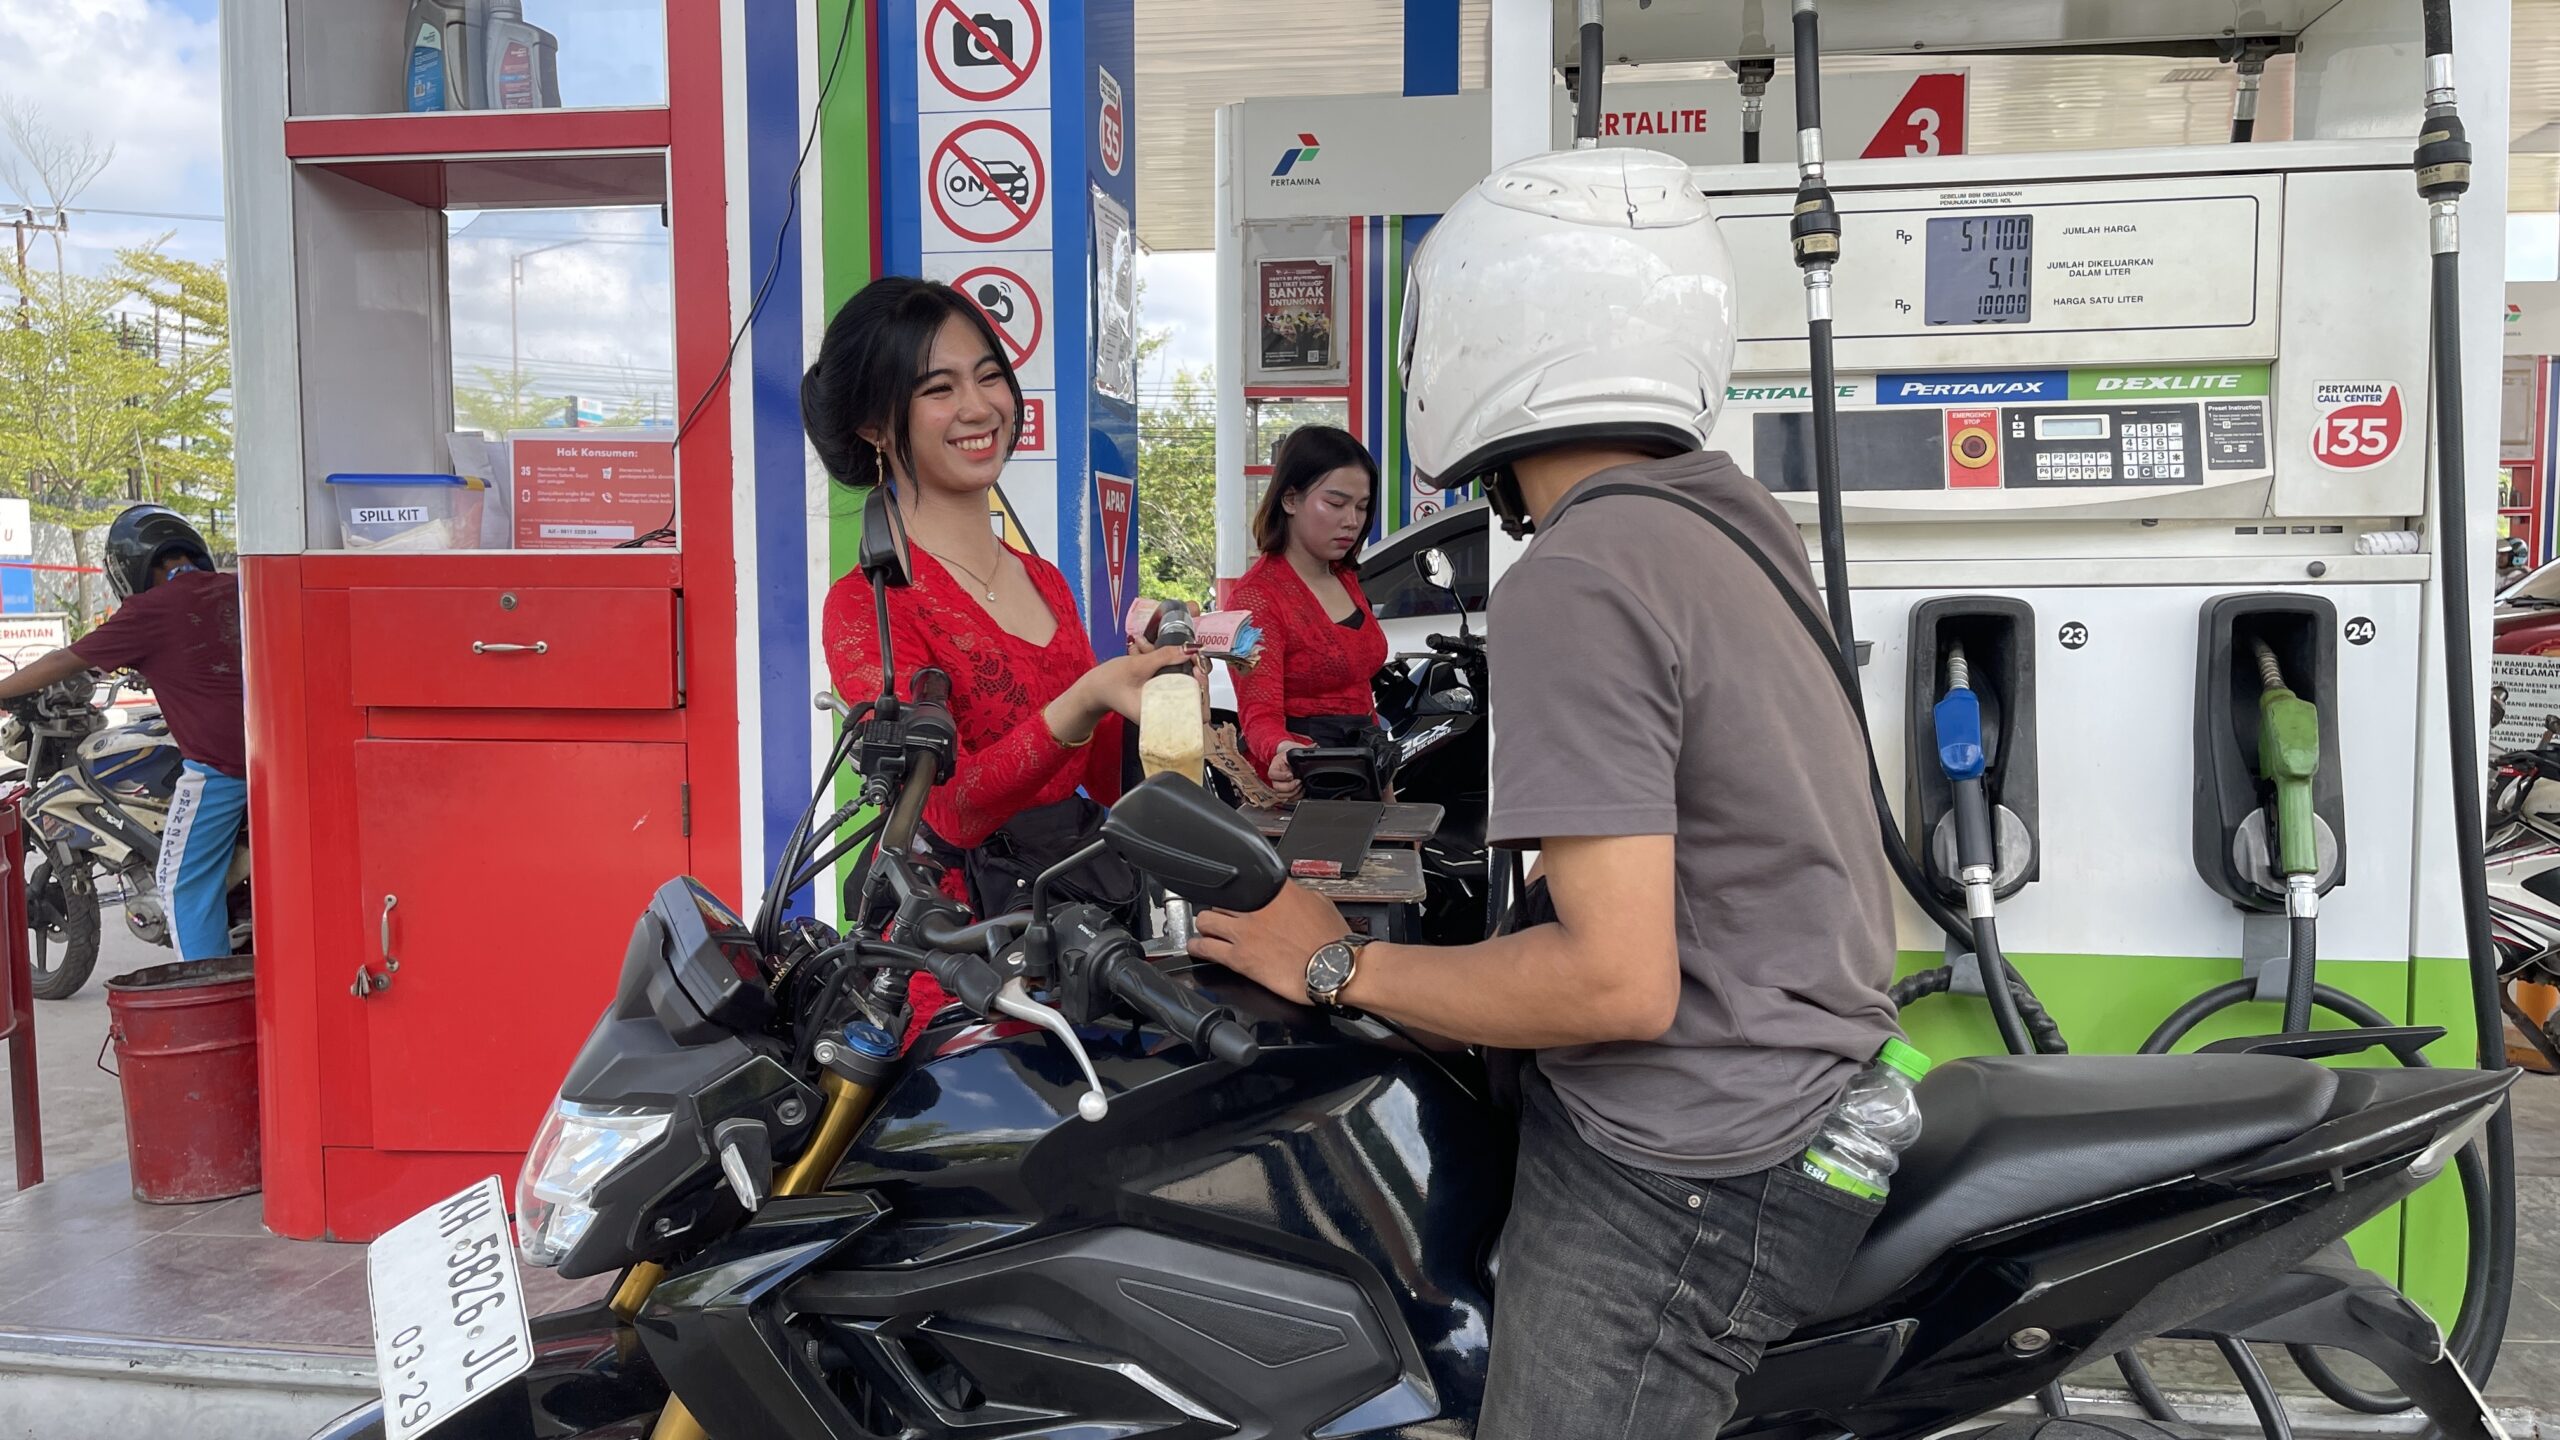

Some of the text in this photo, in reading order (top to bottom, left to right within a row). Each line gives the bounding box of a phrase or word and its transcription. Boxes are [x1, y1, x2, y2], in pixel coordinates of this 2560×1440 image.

[1598, 109, 1707, 136] RTALITE
[1904, 107, 1941, 157] 3
[1101, 114, 1120, 162] 135
[949, 175, 985, 193] ON
[1270, 177, 1321, 187] PERTAMINA
[1940, 192, 1967, 200] SEBELUM
[1982, 190, 2023, 198] DIKELUARKAN
[1960, 217, 2029, 252] 51100
[2062, 224, 2137, 235] JUMLAH HARGA
[2047, 258, 2154, 269] JUMLAH DIKELUARKAN
[2069, 268, 2131, 277] DALAM LITER
[1269, 286, 1324, 298] BANYAK
[1269, 298, 1325, 307] UNTUNGNYA
[1977, 294, 2027, 315] 10000
[2053, 295, 2144, 306] HARGA SATU LITER
[2096, 374, 2242, 392] DEXLITE
[1900, 381, 2044, 397] PERTAMAX
[2318, 384, 2383, 394] PERTAMINA
[2317, 394, 2382, 403] CALL CENTER
[1952, 411, 1992, 419] EMERGENCY
[2124, 425, 2132, 433] 7
[2140, 425, 2148, 433] 8
[2156, 424, 2163, 432] 9
[2126, 438, 2133, 446] 4
[2141, 438, 2149, 446] 5
[2156, 438, 2164, 446] 6
[2318, 418, 2388, 456] 135
[556, 447, 639, 458] Hak Konsumen:
[2127, 452, 2165, 460] 1 2 3
[520, 466, 532, 477] 3S
[2142, 467, 2150, 476] C
[1105, 488, 1126, 513] APAR
[360, 509, 420, 522] SPILL KIT
[2060, 626, 2087, 645] 23
[2346, 622, 2374, 640] 24
[2504, 661, 2560, 669] RAMBU-RAMB
[2501, 667, 2560, 677] KESELAMAT
[173, 789, 191, 824] SMPN
[166, 827, 181, 837] 12
[438, 1184, 518, 1392] KH 5826 JL
